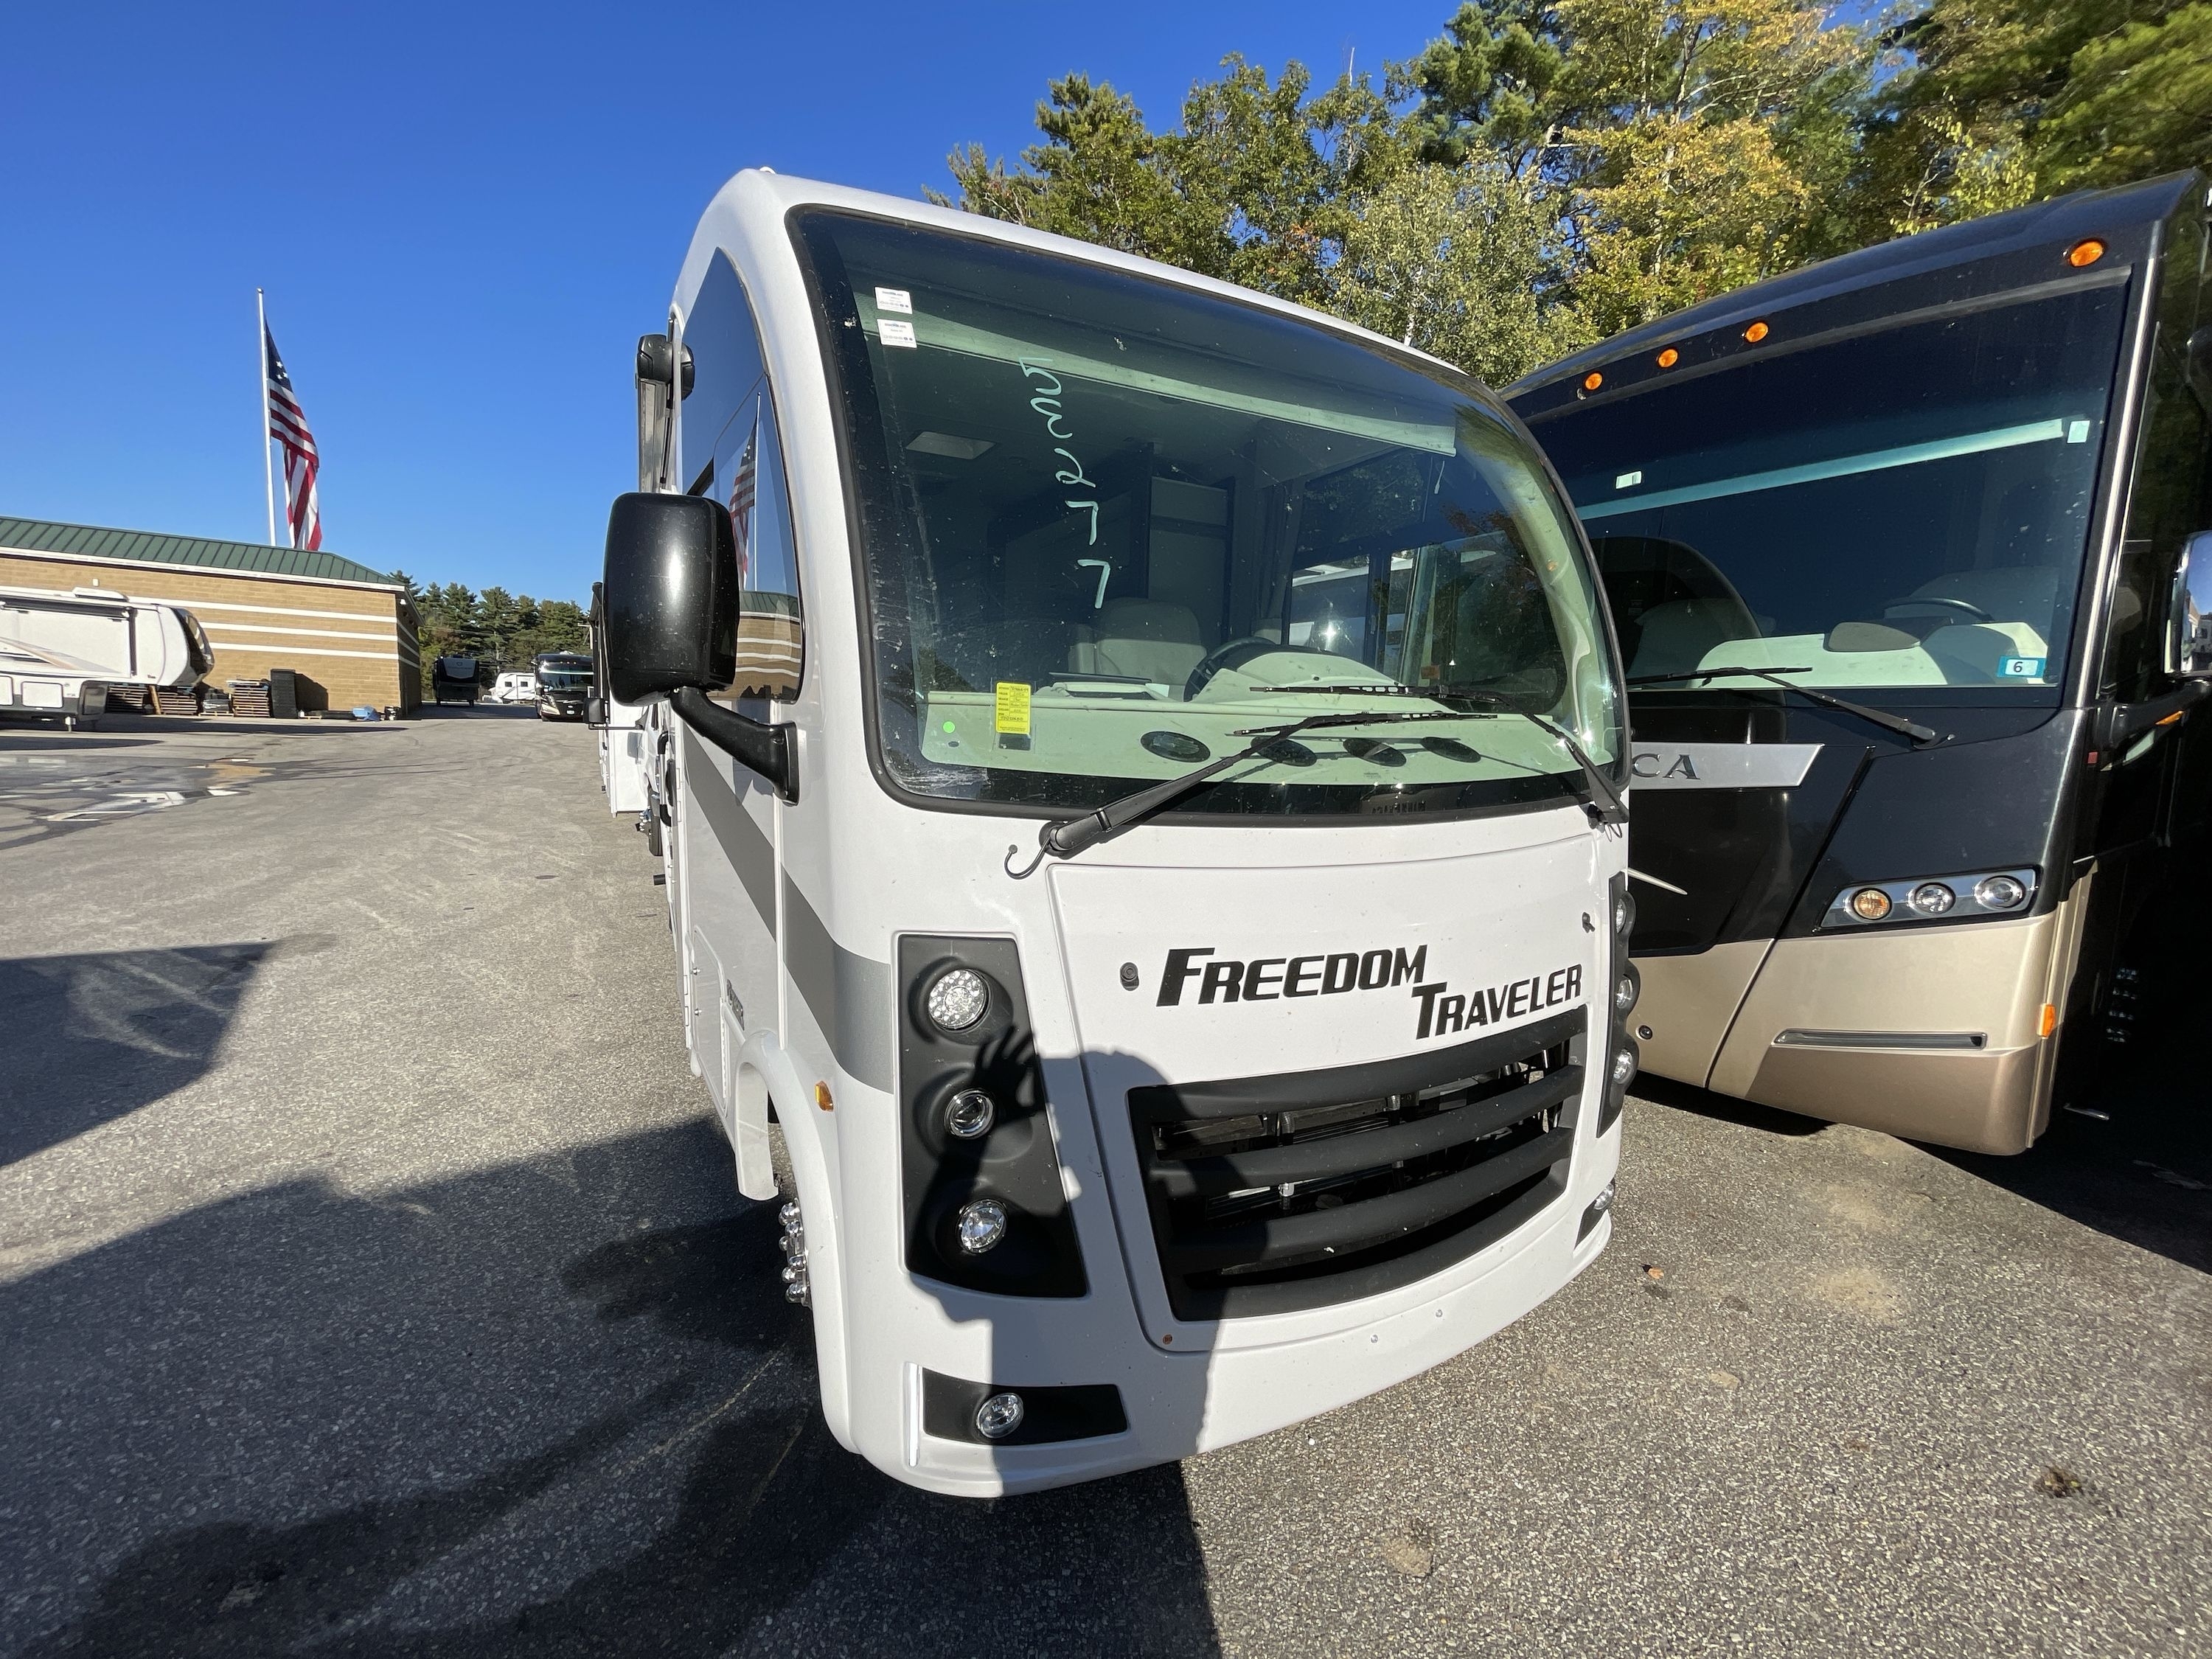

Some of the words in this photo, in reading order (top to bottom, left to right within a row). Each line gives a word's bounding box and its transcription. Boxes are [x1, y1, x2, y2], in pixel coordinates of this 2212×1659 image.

[2014, 661, 2023, 672] 6
[1155, 944, 1428, 1007] FREEDOM
[1411, 963, 1582, 1040] TRAVELER
